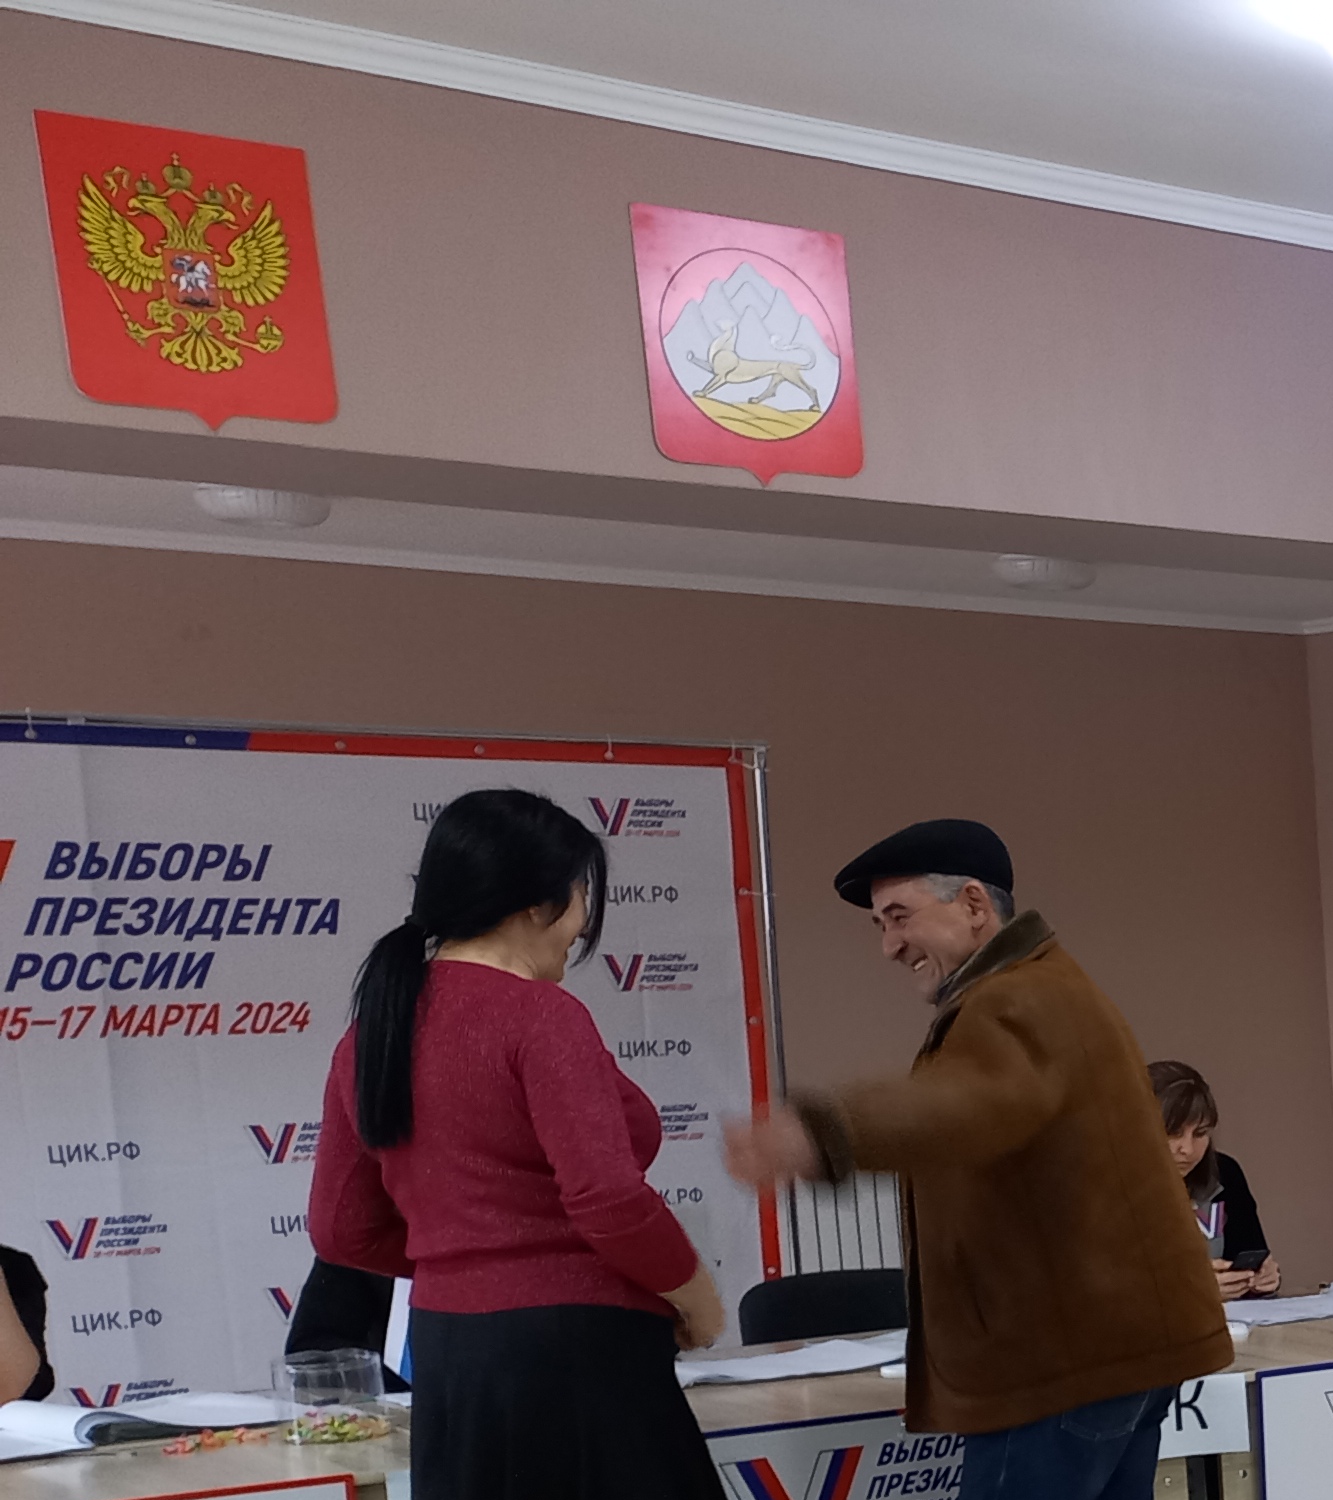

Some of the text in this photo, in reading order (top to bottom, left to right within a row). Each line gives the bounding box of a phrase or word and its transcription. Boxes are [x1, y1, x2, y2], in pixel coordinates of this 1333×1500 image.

[44, 840, 273, 881] ВЫБОРЫ
[606, 885, 679, 906] ЦИК.РФ
[24, 896, 340, 942] ПРЕЗИДЕНТА
[5, 951, 215, 992] РОССИИ
[100, 1003, 221, 1038] МАРТА
[228, 1001, 311, 1035] 2024
[618, 1039, 691, 1060] ЦИК.РФ
[47, 1141, 141, 1168] ЦИК.РФ
[71, 1308, 162, 1336] ЦИК.РФ
[877, 1434, 966, 1466] ВЫБОР
